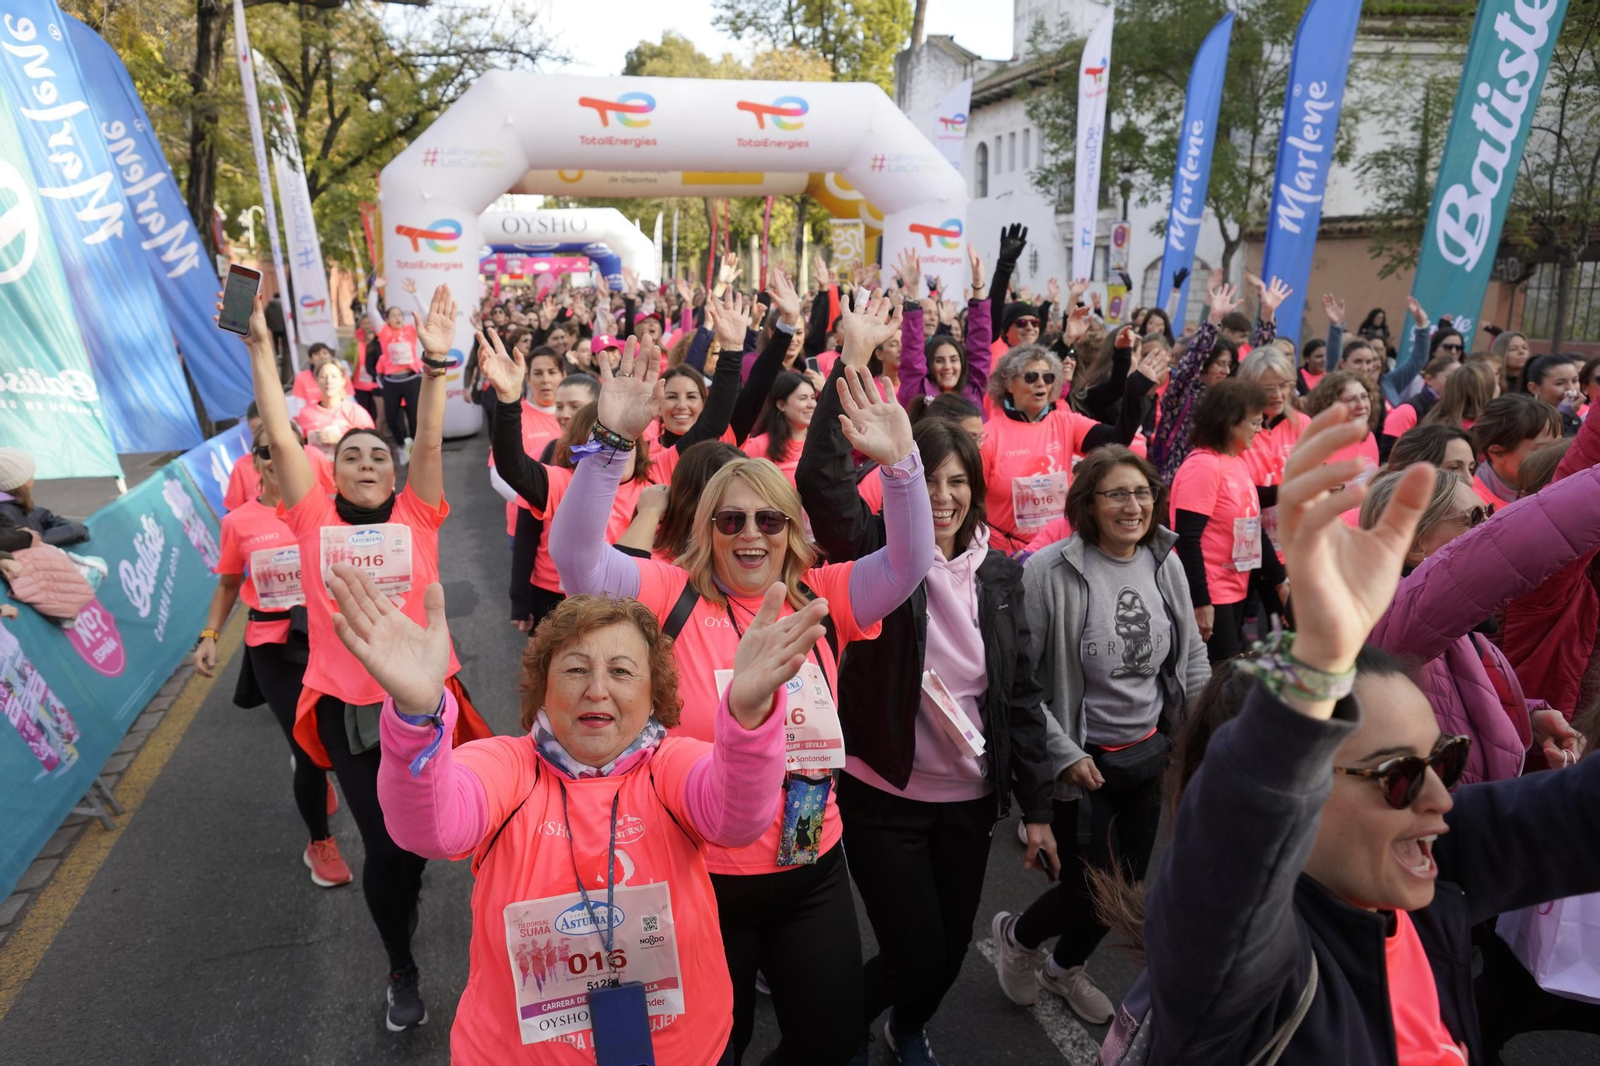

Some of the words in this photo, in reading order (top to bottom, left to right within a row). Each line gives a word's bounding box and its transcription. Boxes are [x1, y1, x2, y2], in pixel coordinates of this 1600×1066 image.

[579, 135, 657, 148] TotalEnergies
[736, 137, 809, 150] TotalEnergies
[1277, 80, 1335, 234] Marlene
[621, 175, 658, 185] Deportes
[1169, 120, 1204, 251] Marlene
[502, 216, 587, 234] OYSHO
[396, 259, 463, 272] TotalEnergies
[1033, 496, 1053, 506] 016
[351, 555, 384, 567] 016
[277, 570, 302, 582] 016
[1087, 634, 1170, 657] GRUMP
[795, 755, 832, 763] Santander
[527, 920, 550, 928] DORSAL
[520, 925, 552, 938] SUMA
[568, 949, 628, 975] 016
[541, 998, 575, 1012] CARRERA
[576, 995, 587, 1004] DE
[539, 1010, 589, 1031] OYSHO
